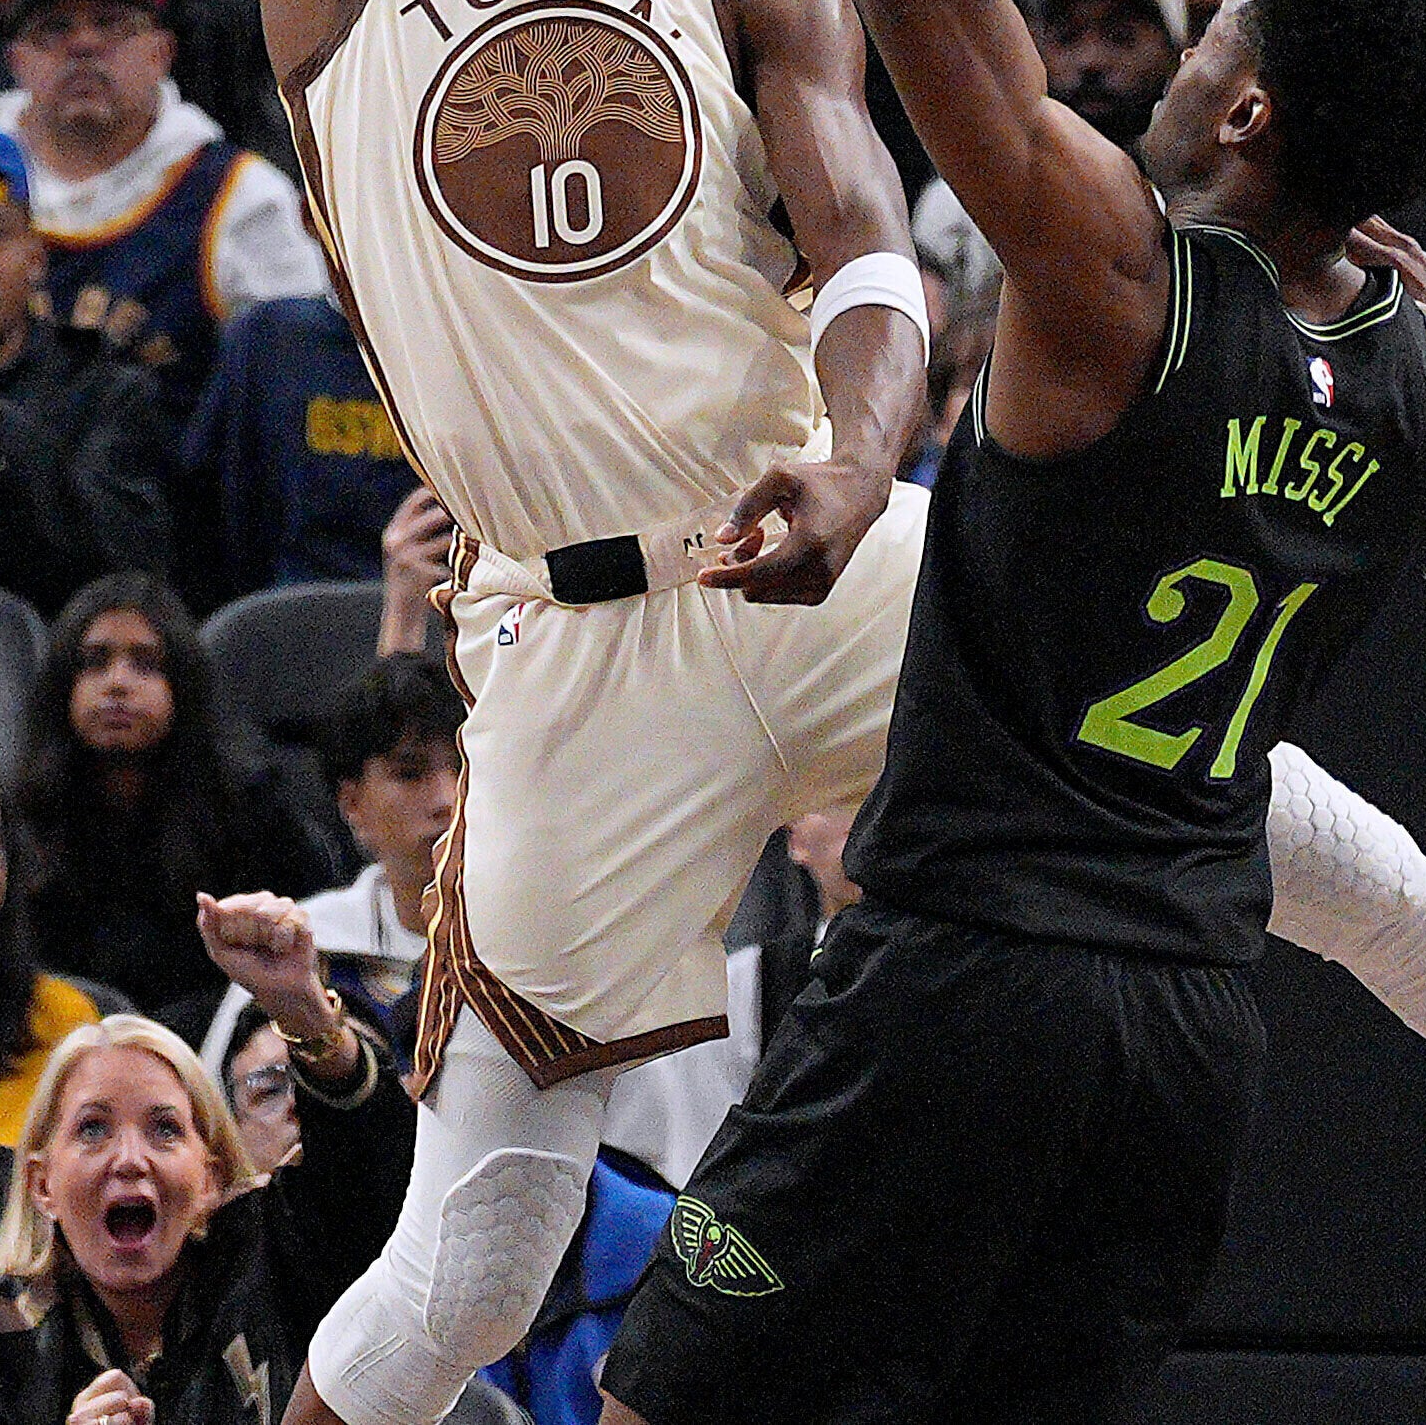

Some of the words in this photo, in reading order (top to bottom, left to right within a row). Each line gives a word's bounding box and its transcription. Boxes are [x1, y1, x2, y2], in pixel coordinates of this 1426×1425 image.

[531, 159, 603, 248] 10
[1220, 415, 1380, 527] MISSI
[1077, 558, 1319, 778] 21
